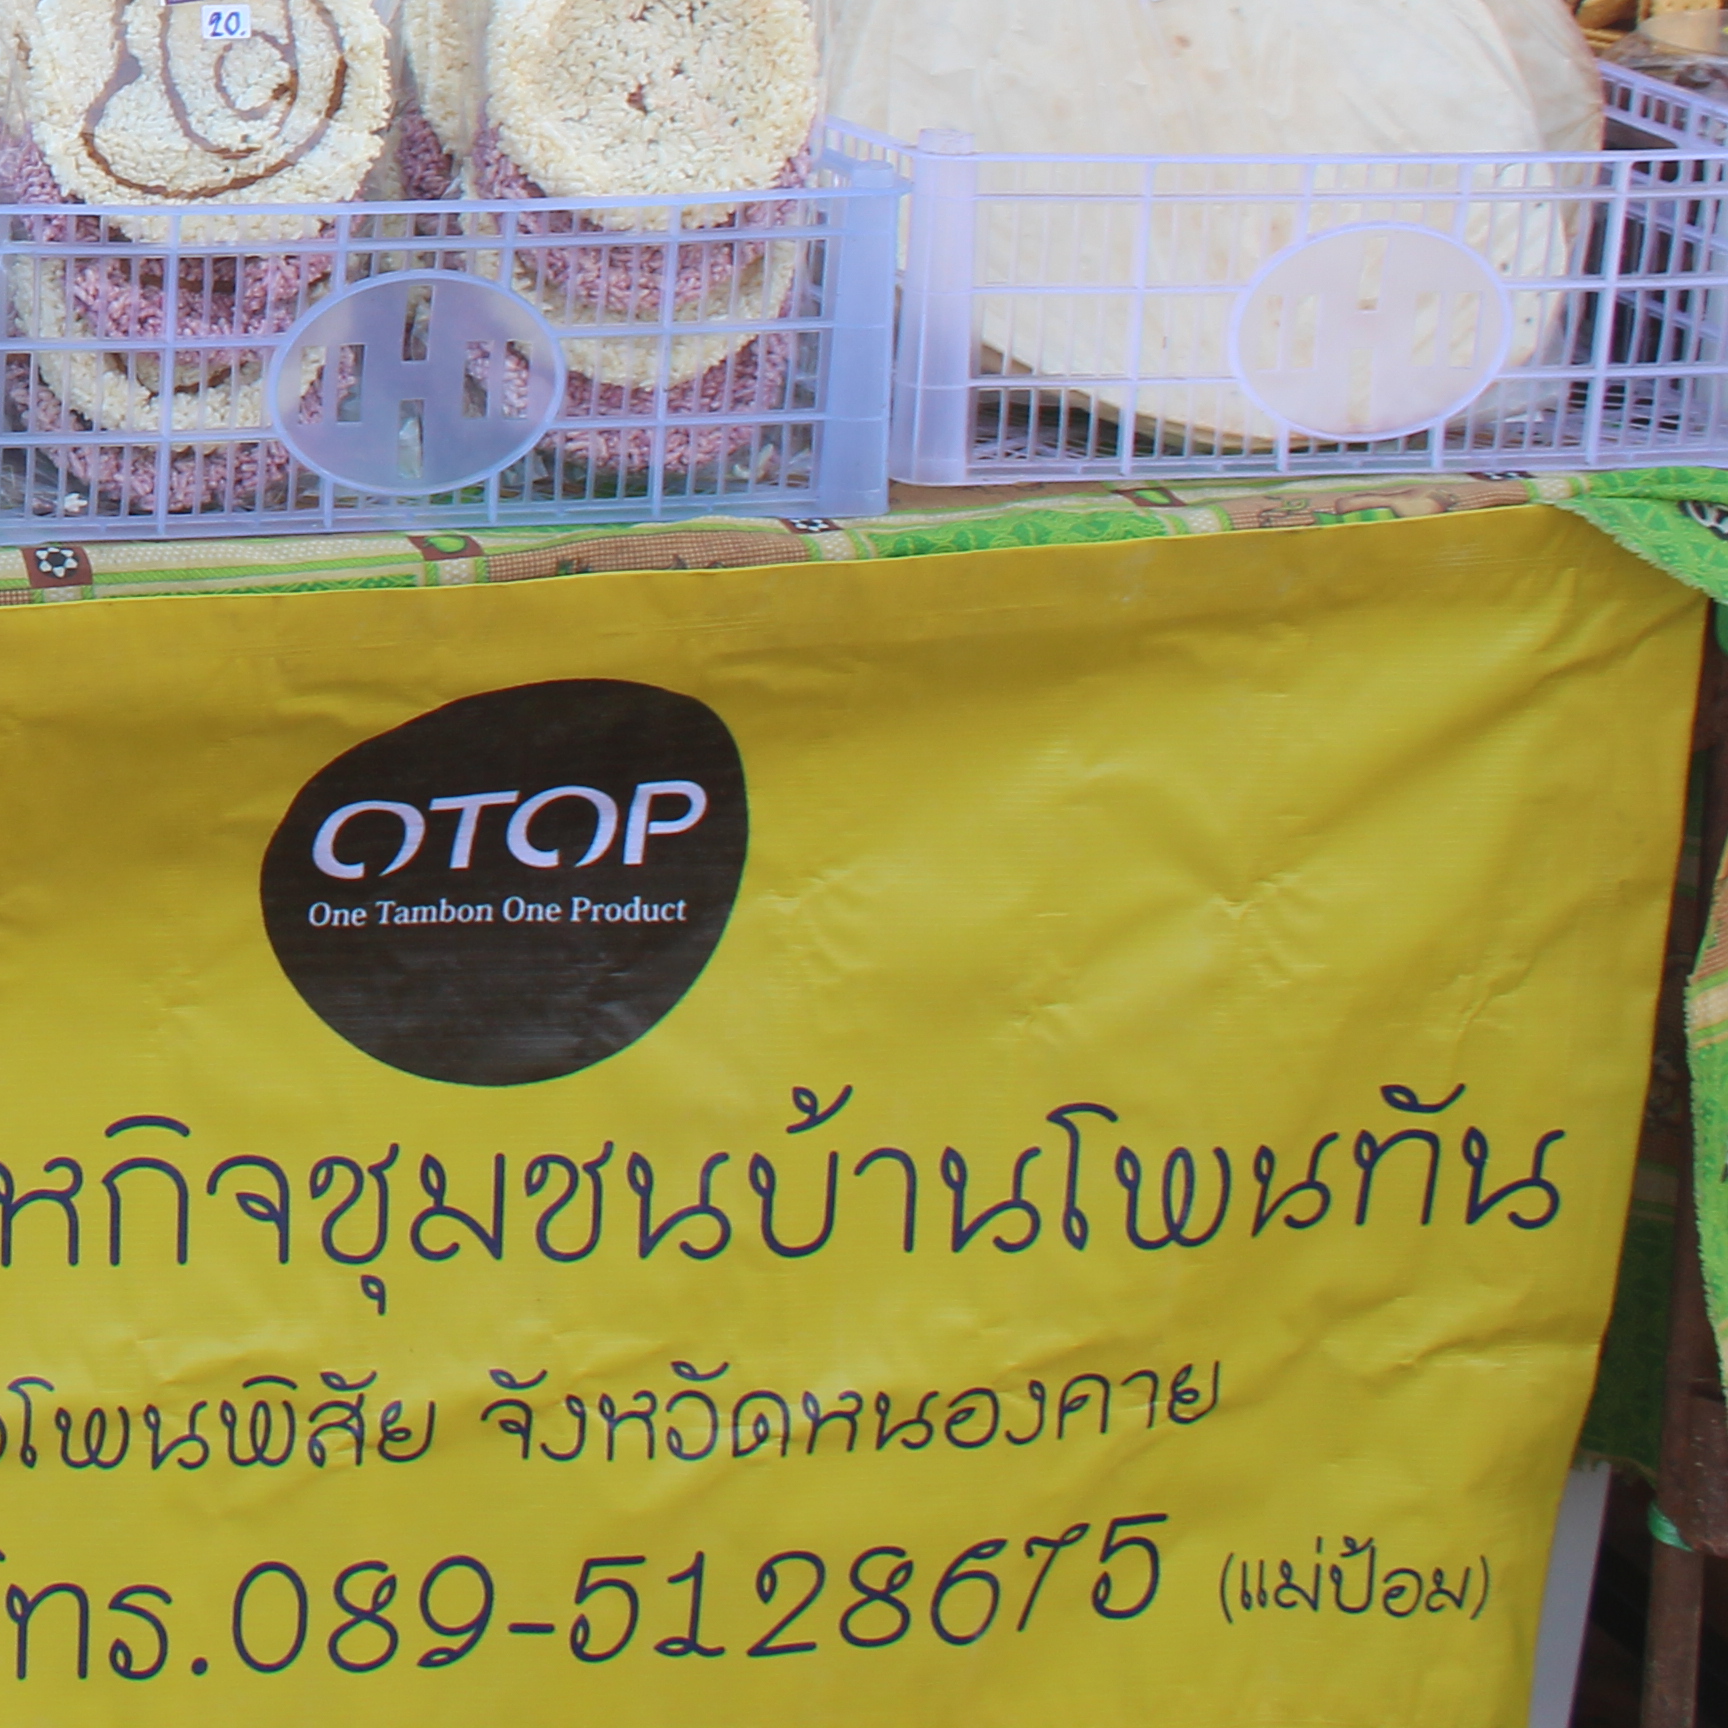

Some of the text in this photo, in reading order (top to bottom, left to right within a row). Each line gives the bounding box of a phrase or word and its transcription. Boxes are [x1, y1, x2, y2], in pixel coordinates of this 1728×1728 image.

[312, 779, 708, 880] OTOP
[307, 895, 687, 928] One Tambon One Product
[480, 1359, 1220, 1462] จังหวัดหนองคาย
[1218, 1535, 1490, 1623] (แม่ป้อม)
